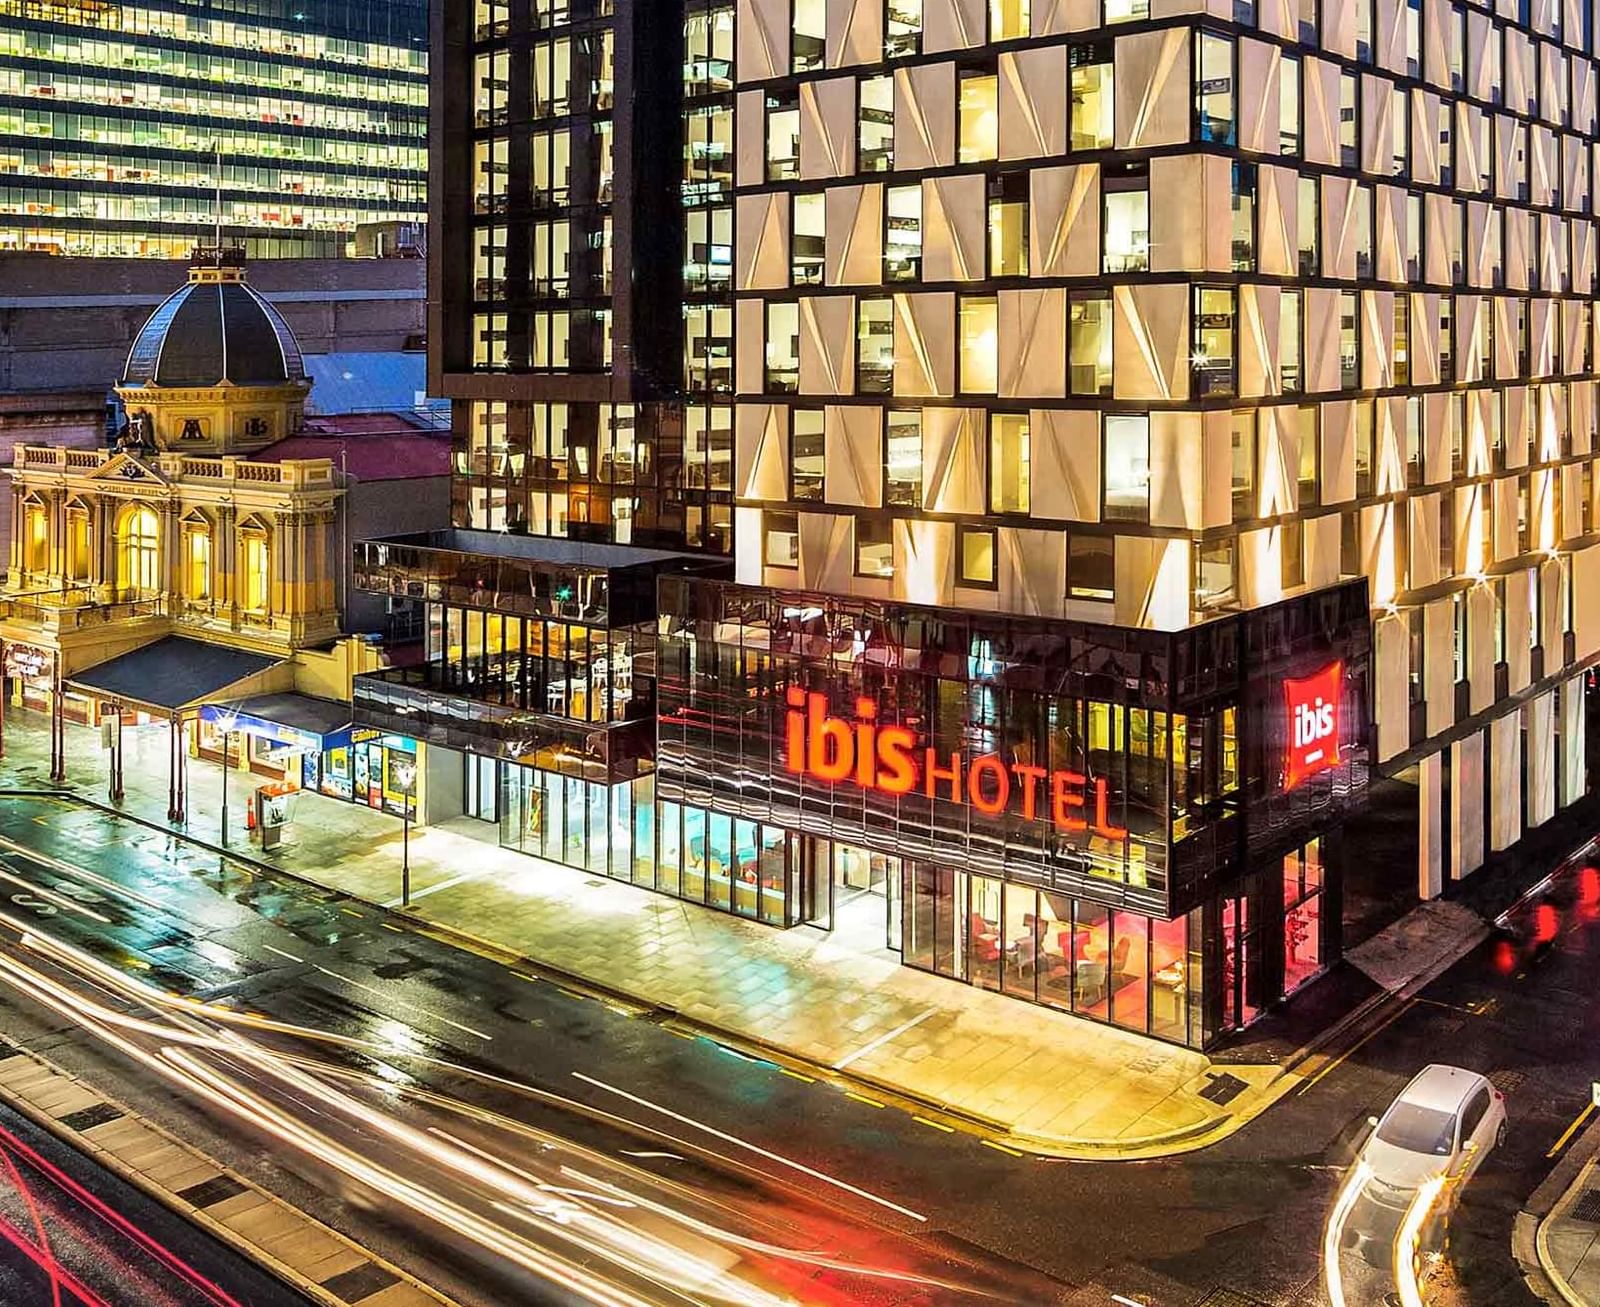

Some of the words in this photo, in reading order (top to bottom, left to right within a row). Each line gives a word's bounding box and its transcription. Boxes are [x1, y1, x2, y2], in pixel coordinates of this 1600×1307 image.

[786, 686, 917, 795] ibis
[925, 747, 1127, 841] HOTEL
[1294, 697, 1333, 748] ibis
